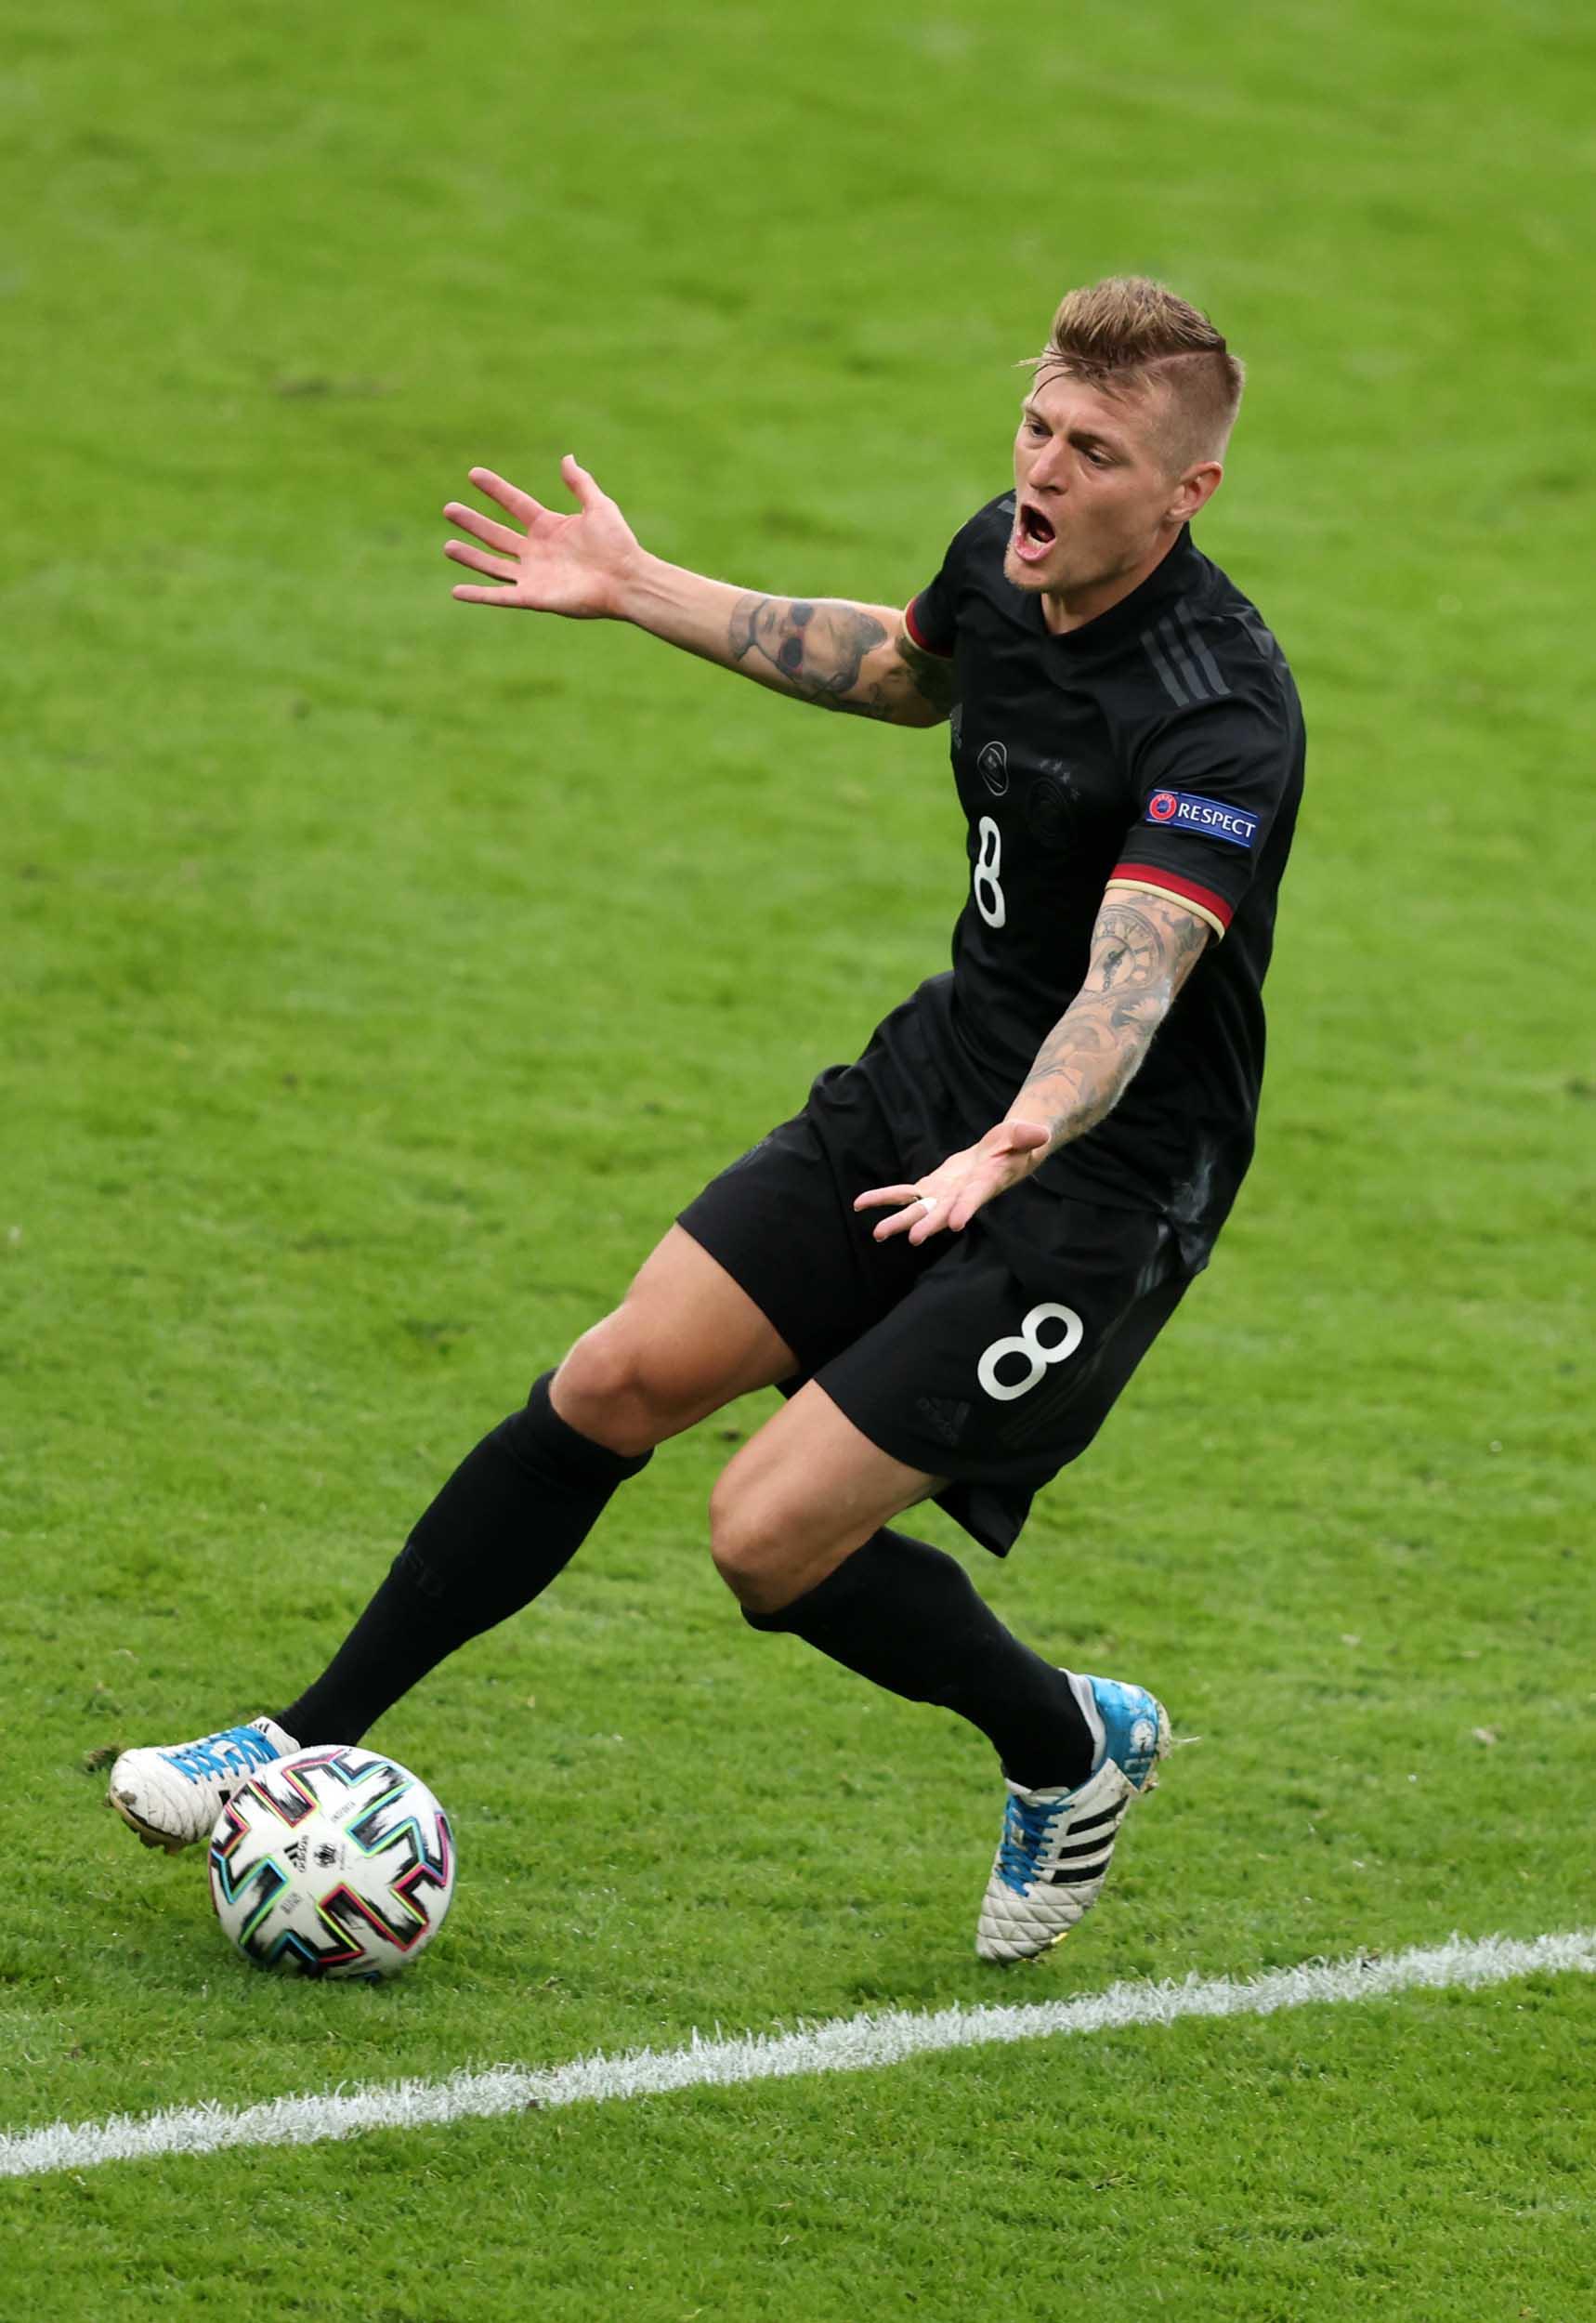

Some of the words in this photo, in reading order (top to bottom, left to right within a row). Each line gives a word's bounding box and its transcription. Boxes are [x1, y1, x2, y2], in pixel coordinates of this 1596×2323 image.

[1177, 802, 1256, 838] RESPECT
[974, 816, 1005, 928] 8
[977, 1303, 1084, 1401] 8
